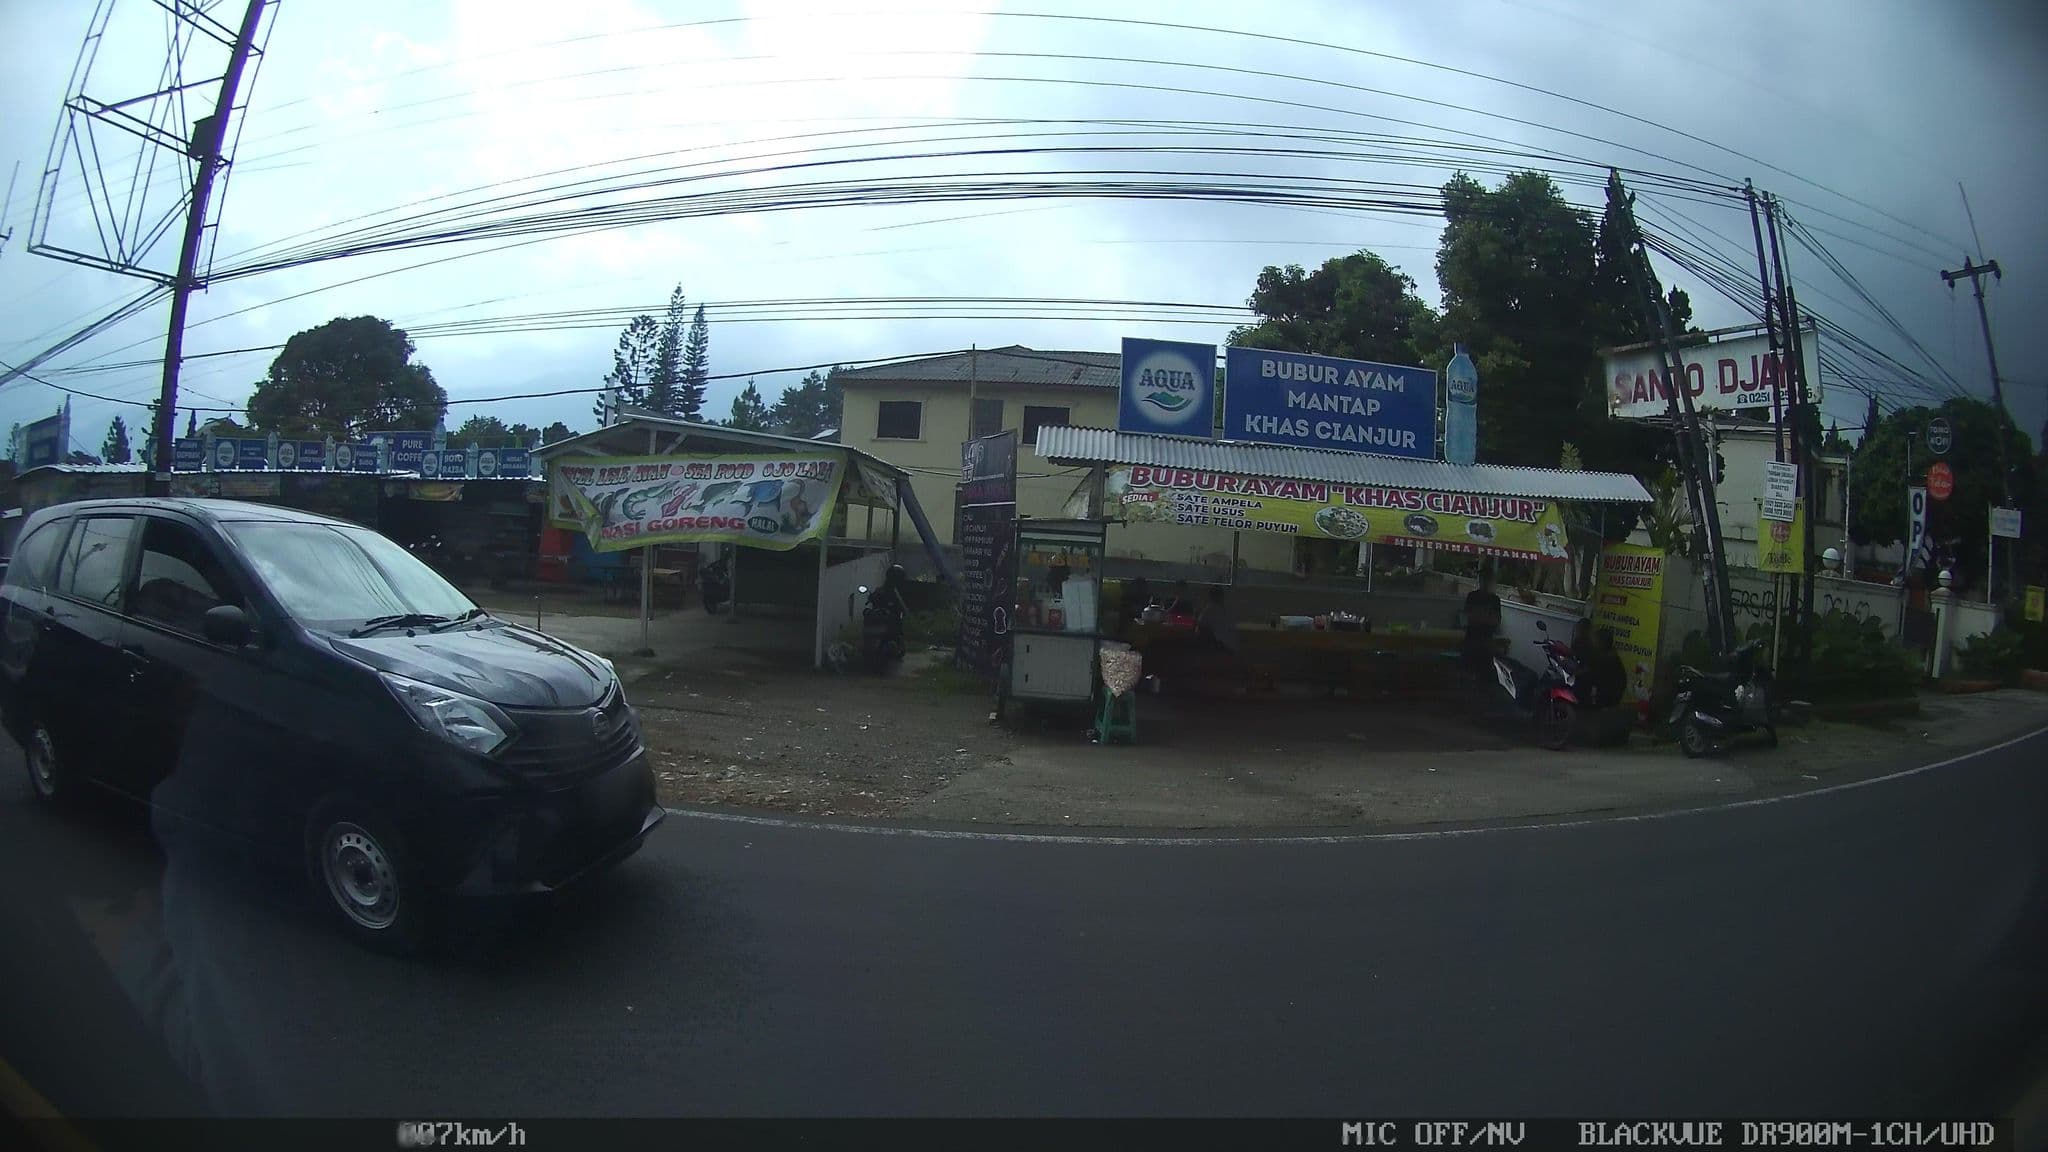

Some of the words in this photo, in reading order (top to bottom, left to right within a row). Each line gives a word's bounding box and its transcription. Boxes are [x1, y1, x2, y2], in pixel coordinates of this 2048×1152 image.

[1139, 367, 1196, 391] AQUA
[1262, 359, 1339, 385] BUBUR
[1344, 367, 1404, 393] AYAM
[1450, 378, 1475, 393] AQUA
[1288, 390, 1381, 416] MANTAP
[1245, 414, 1309, 438] KHAS
[1315, 421, 1416, 449] CIANJUR
[402, 440, 423, 449] PURE
[397, 452, 422, 462] COFFE
[684, 463, 713, 480] SEA
[714, 463, 755, 479] FOOD
[1130, 466, 1238, 493] BUBUR
[1241, 477, 1328, 502] AYAM
[1332, 484, 1423, 511] "KHAS
[1424, 490, 1545, 523] CIANJUR"
[1177, 493, 1208, 504] SATE
[1212, 497, 1263, 509] AMPELA
[1177, 503, 1209, 514] SATE
[1213, 507, 1245, 517] USUS
[647, 516, 747, 533] GORENG
[751, 517, 776, 532] HALAL
[1177, 513, 1209, 525] SATE
[1213, 517, 1252, 530] TELOR
[1256, 521, 1298, 534] PUYUH
[1394, 538, 1470, 554] MENERIMA
[1477, 545, 1539, 560] PESANAN
[1635, 556, 1660, 573] AYAM
